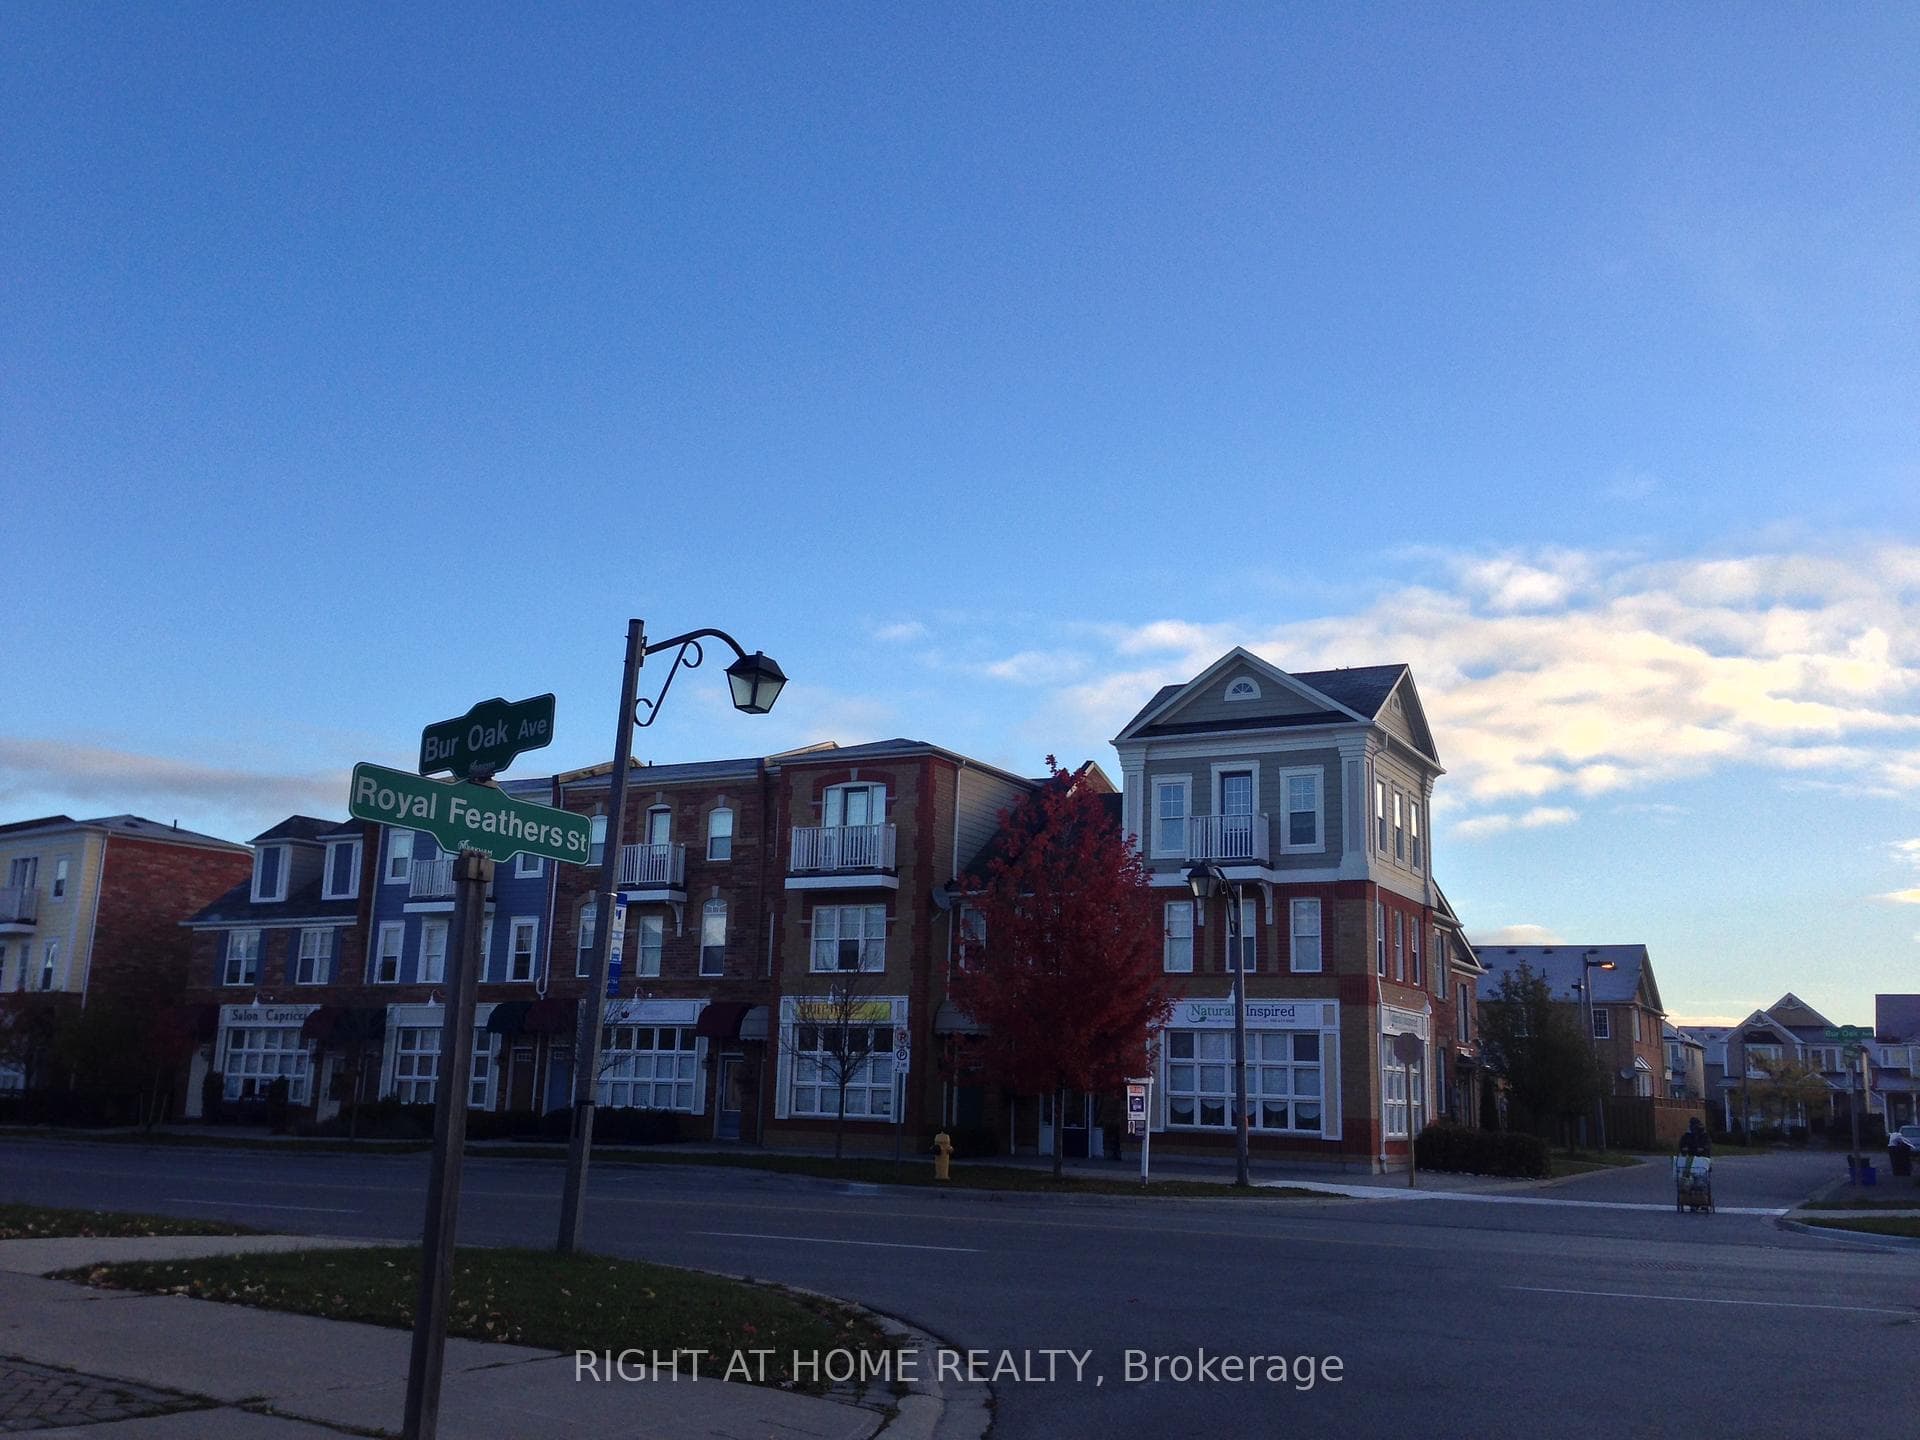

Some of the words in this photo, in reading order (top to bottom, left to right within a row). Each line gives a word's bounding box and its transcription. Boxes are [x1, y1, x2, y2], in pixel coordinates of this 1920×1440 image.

[424, 735, 459, 763] Bur
[467, 718, 509, 752] Oak
[517, 718, 547, 740] Ave
[356, 775, 438, 820] Royal
[448, 796, 563, 848] Feathers
[566, 829, 588, 853] St
[232, 1008, 258, 1021] Salon
[1245, 1003, 1296, 1019] Inspired
